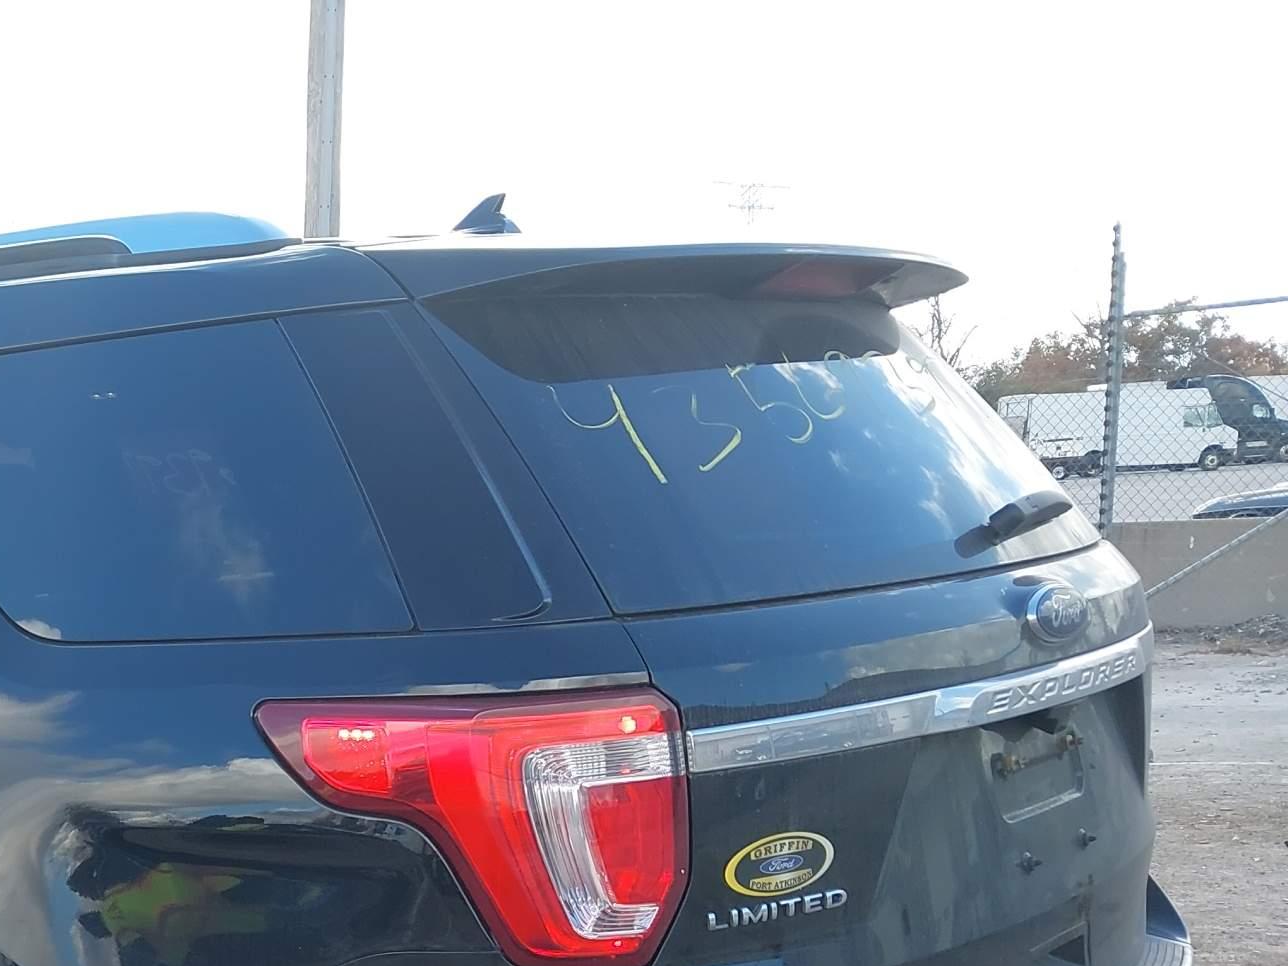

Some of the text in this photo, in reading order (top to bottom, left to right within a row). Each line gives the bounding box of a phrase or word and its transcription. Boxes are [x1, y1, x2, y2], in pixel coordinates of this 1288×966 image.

[1052, 590, 1086, 628] Ford
[986, 655, 1137, 715] EXPLORER
[754, 839, 810, 859] GRIFFIN
[768, 857, 795, 872] Ford
[773, 871, 813, 891] ATKINSON
[707, 889, 848, 931] LIMITED
